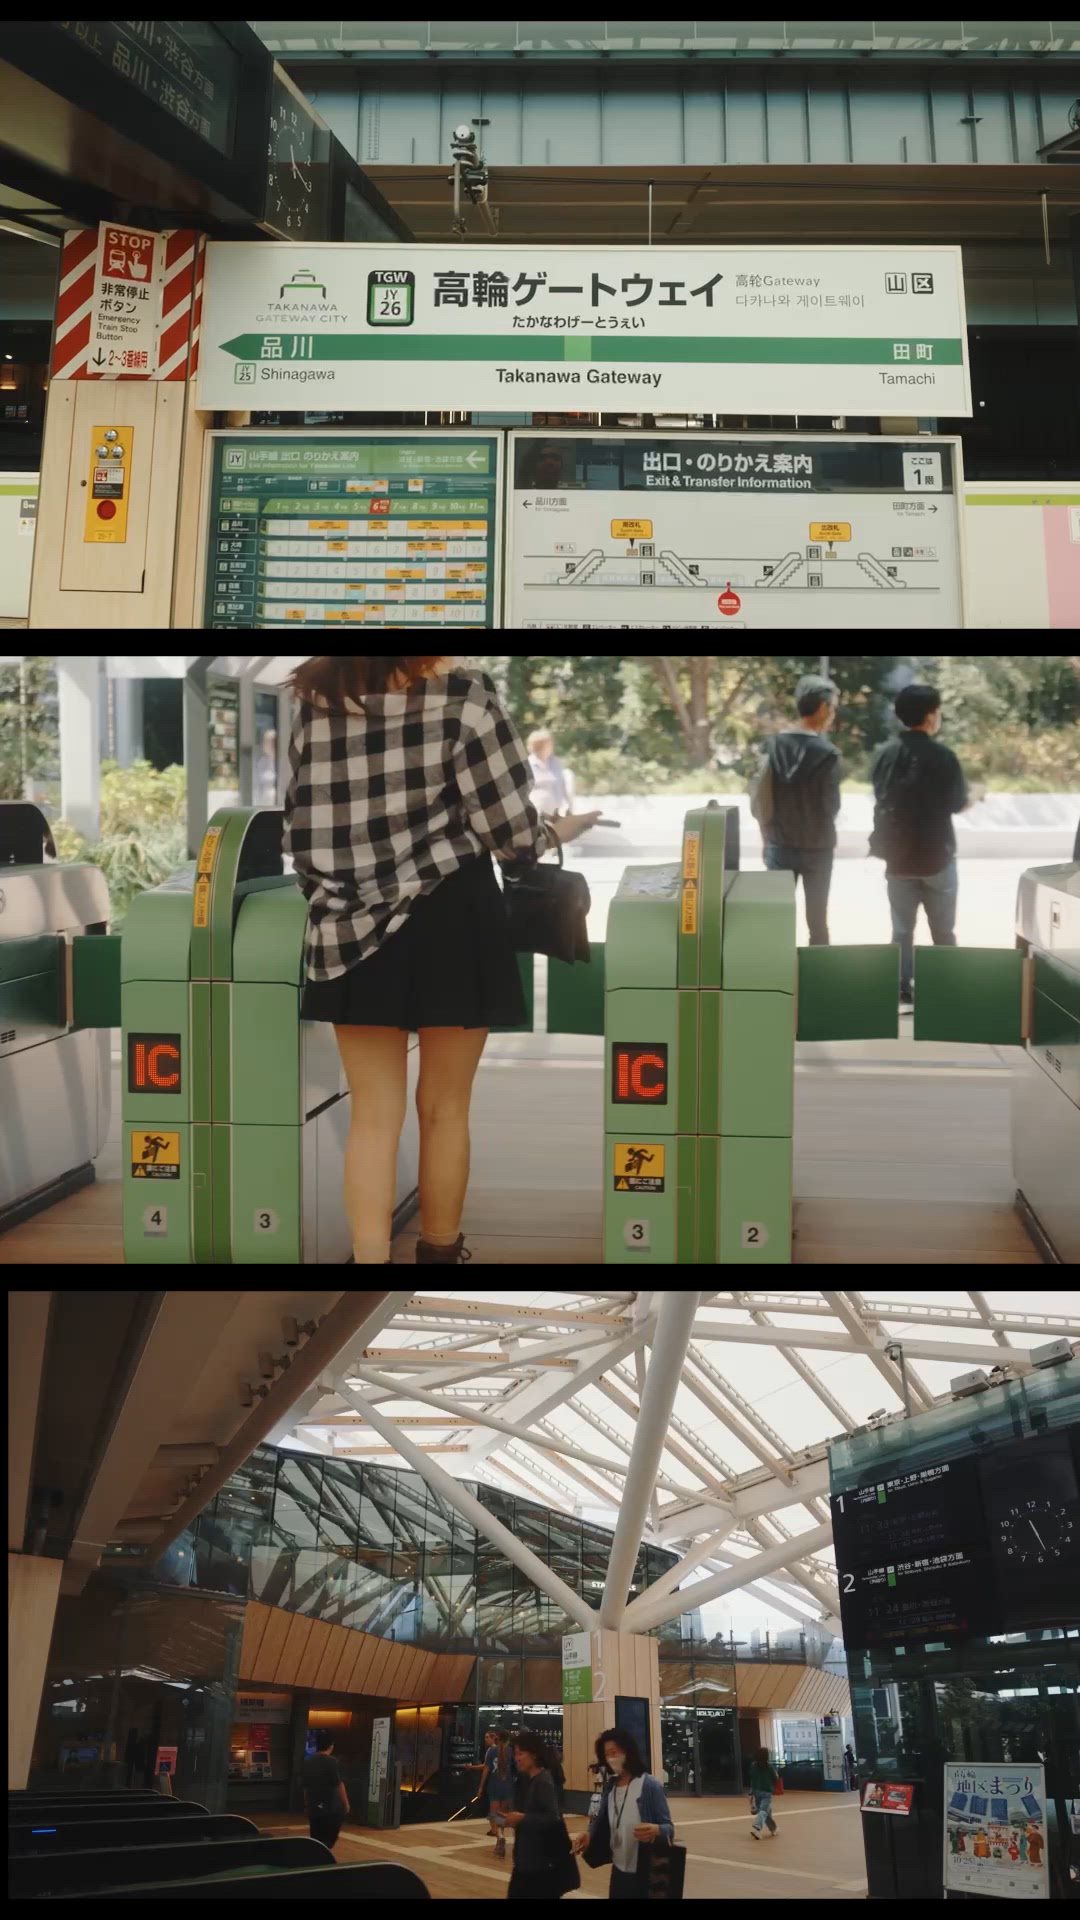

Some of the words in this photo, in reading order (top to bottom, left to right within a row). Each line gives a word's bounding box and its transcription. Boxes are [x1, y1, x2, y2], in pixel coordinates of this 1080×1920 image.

[270, 116, 277, 131] 10
[291, 112, 297, 126] 12
[109, 232, 151, 250] STOP
[375, 272, 408, 283] TGW
[101, 282, 150, 301] 非常停止
[384, 289, 398, 300] JY
[433, 271, 723, 307] 高輪ゲートウェイ
[100, 299, 137, 314] ボタン
[267, 303, 338, 312] TAKANAWA
[735, 294, 791, 308] 다카나와
[796, 294, 865, 308] 게이트웨이
[379, 302, 401, 316] 26
[98, 313, 141, 325] Emergency
[255, 315, 316, 323] GATEWAY
[320, 315, 348, 323] CITY
[512, 315, 645, 329] たかなわげーとうぇい
[98, 323, 118, 331] Train
[120, 324, 138, 333] Stop
[96, 332, 123, 341] Button
[260, 336, 314, 359] 品川
[893, 343, 933, 360] 田町
[238, 372, 251, 381] 25
[261, 368, 335, 383] Shinagawa
[495, 368, 581, 384] Takanawa
[586, 369, 662, 387] Gateway
[878, 372, 936, 385] Tamachi
[230, 454, 241, 463] JY
[643, 451, 813, 474] 出口・のりかえ案内
[911, 457, 933, 465] ここは
[646, 475, 670, 486] Exit
[672, 475, 681, 487] &
[682, 475, 735, 487] Transfer
[738, 477, 811, 489] Information
[535, 497, 567, 506] 品川方面
[892, 502, 925, 511] 田町方面
[135, 1044, 179, 1087] IC
[618, 1054, 664, 1097] IC
[151, 1210, 162, 1226] 4
[259, 1213, 271, 1229] 3
[632, 1224, 644, 1240] 3
[747, 1227, 759, 1242] 2
[836, 1495, 845, 1513] 1
[1000, 1520, 1010, 1528] 10
[1067, 1521, 1073, 1529] 3
[1007, 1547, 1013, 1555] 8
[842, 1573, 856, 1593] 2
[593, 1670, 607, 1702] 2
[957, 1776, 1033, 1795] 地区まつり
